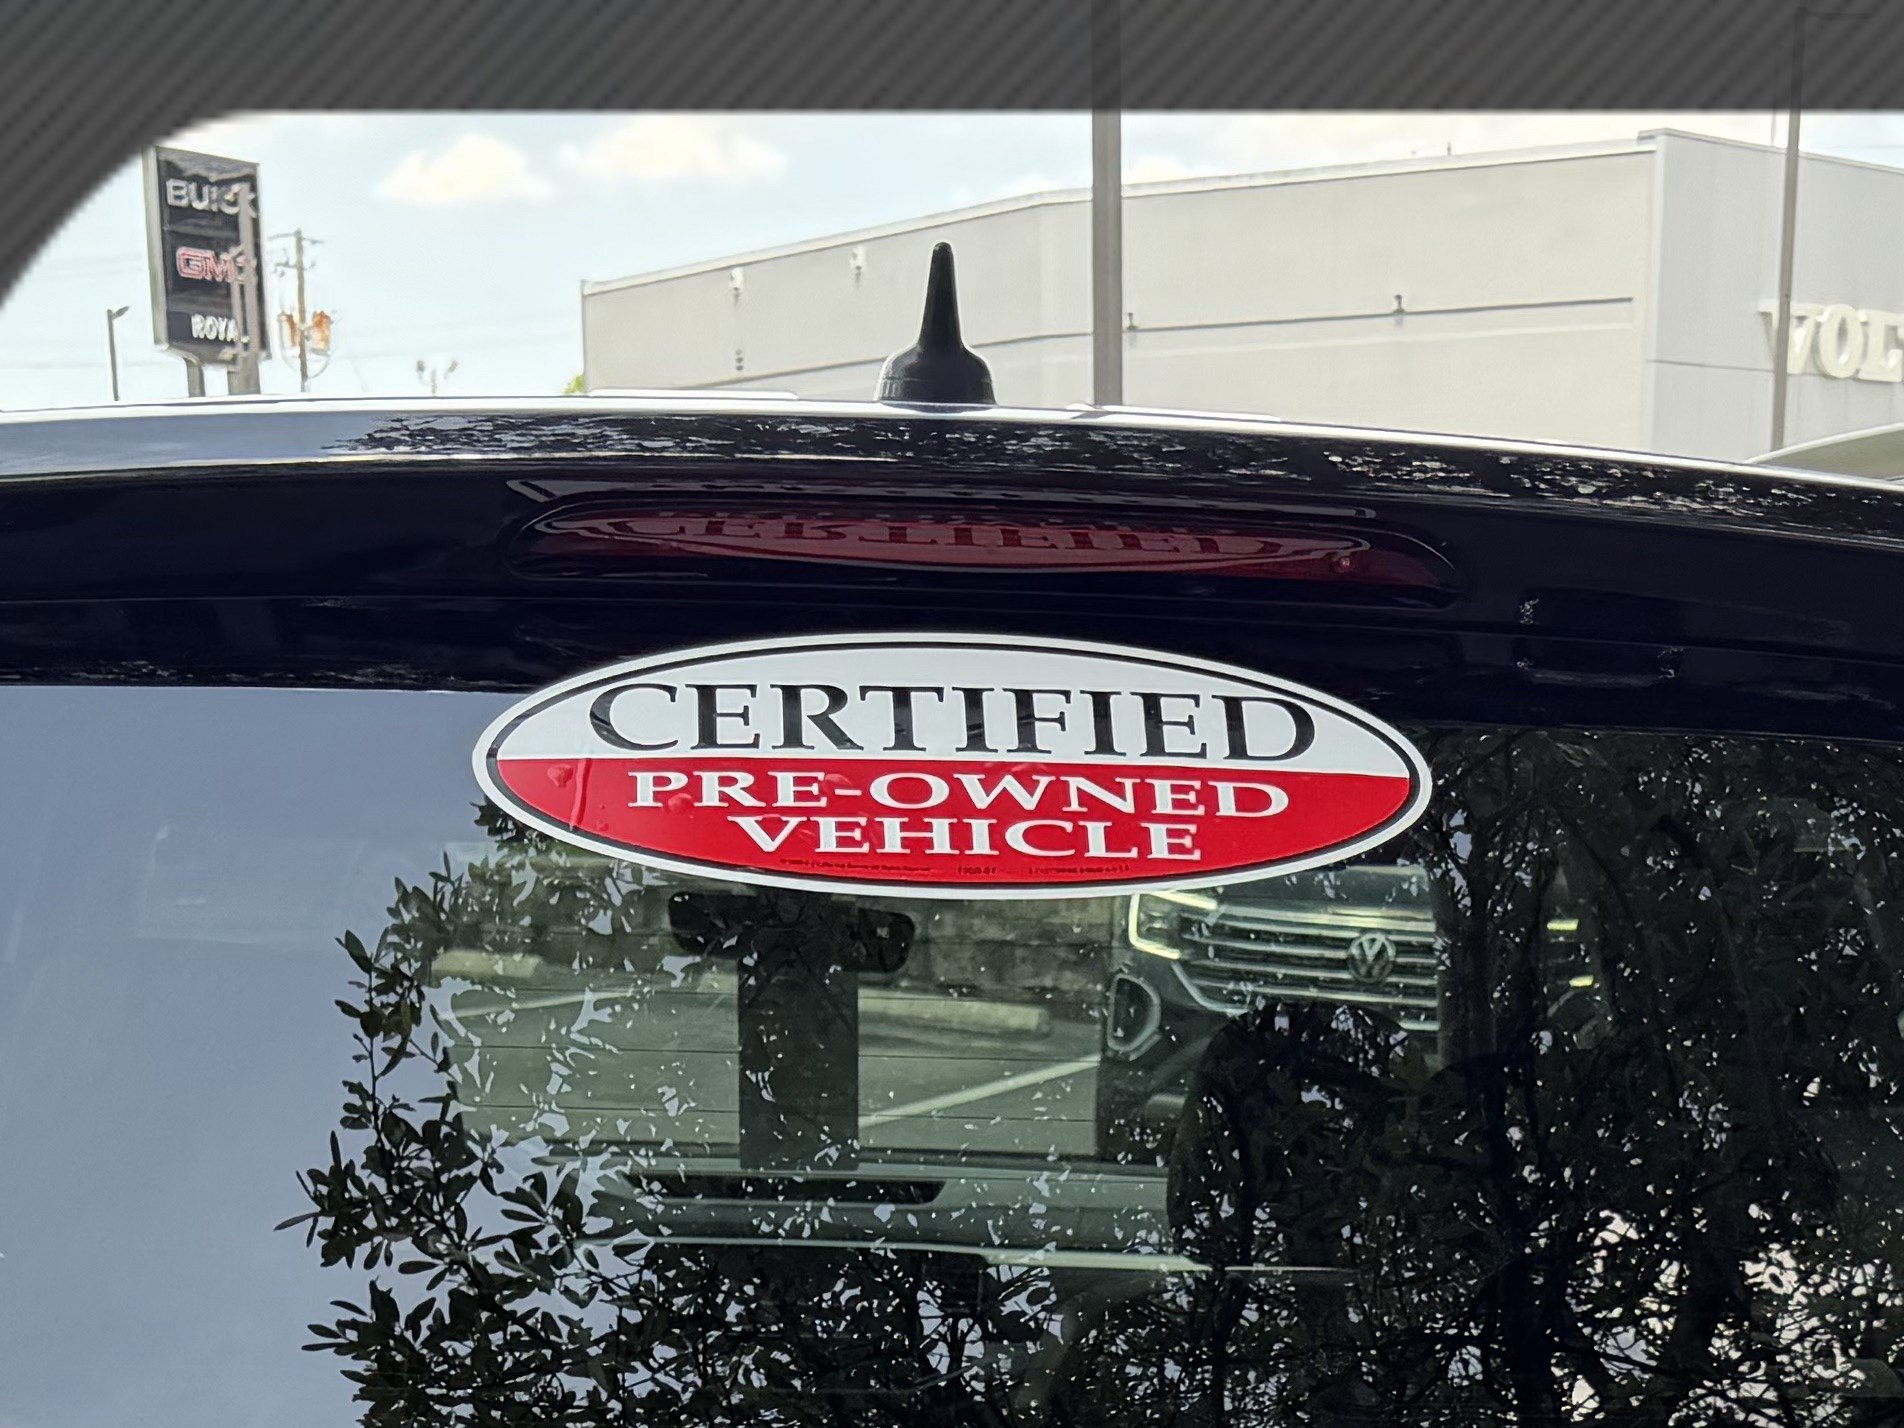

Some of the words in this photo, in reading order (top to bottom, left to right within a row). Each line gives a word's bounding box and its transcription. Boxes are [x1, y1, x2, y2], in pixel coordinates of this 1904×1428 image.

[587, 682, 1317, 762] CERTIFIED
[628, 770, 1289, 819] PRE-OWNED
[727, 814, 1202, 861] VEHICLE
